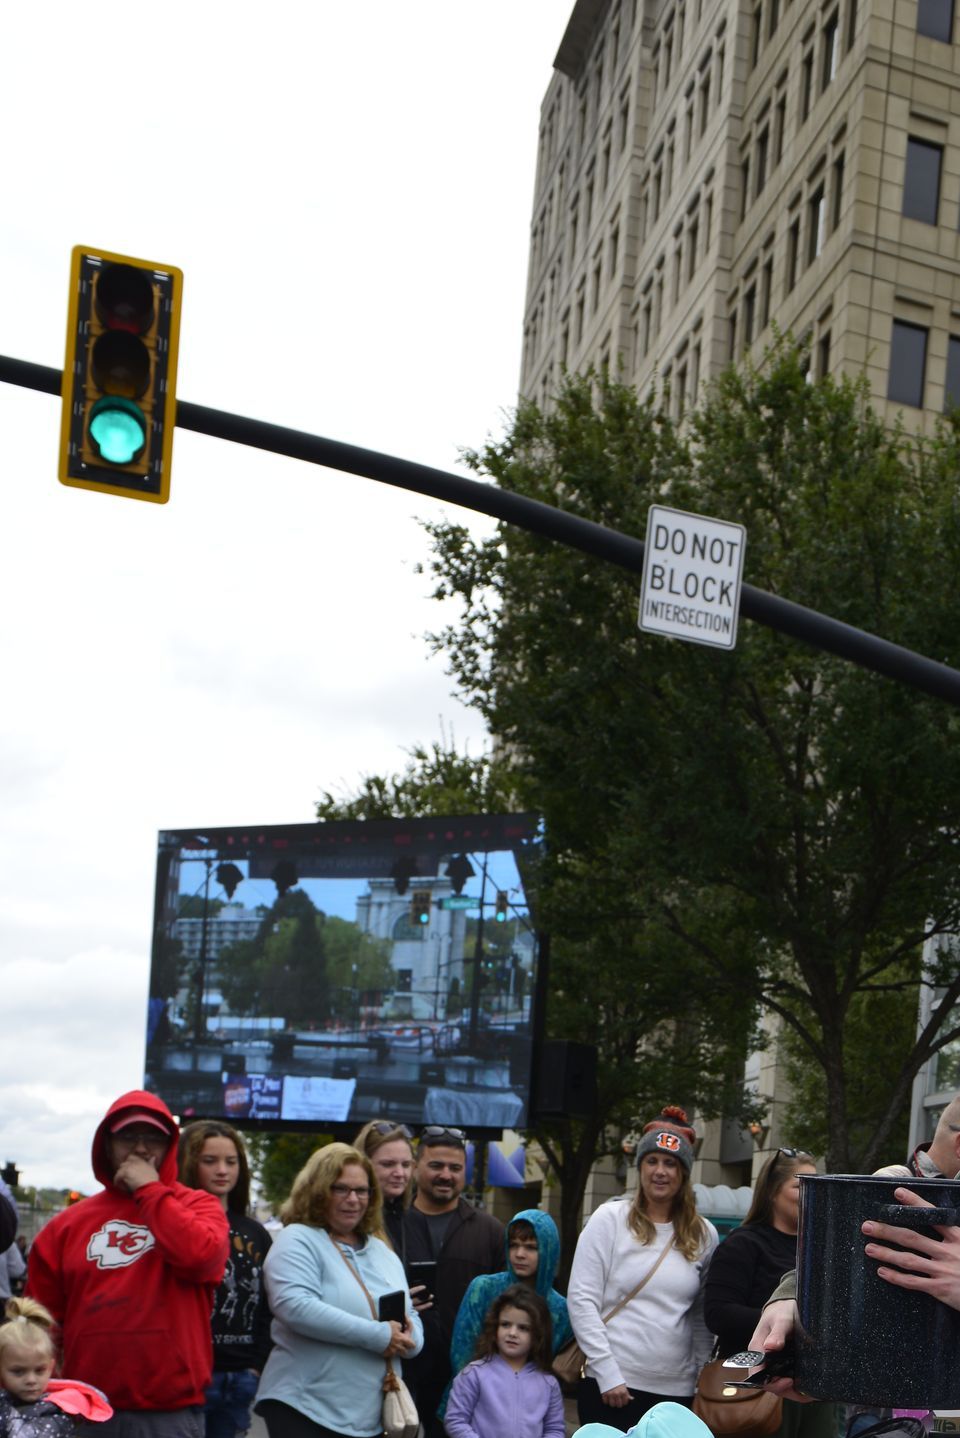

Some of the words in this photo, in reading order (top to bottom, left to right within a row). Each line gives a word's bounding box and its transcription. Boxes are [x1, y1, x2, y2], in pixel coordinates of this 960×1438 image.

[654, 524, 686, 555] DO
[691, 533, 738, 567] NOT
[650, 564, 733, 607] BLOCK
[645, 600, 731, 634] INTERSECTION
[106, 1230, 148, 1256] KC
